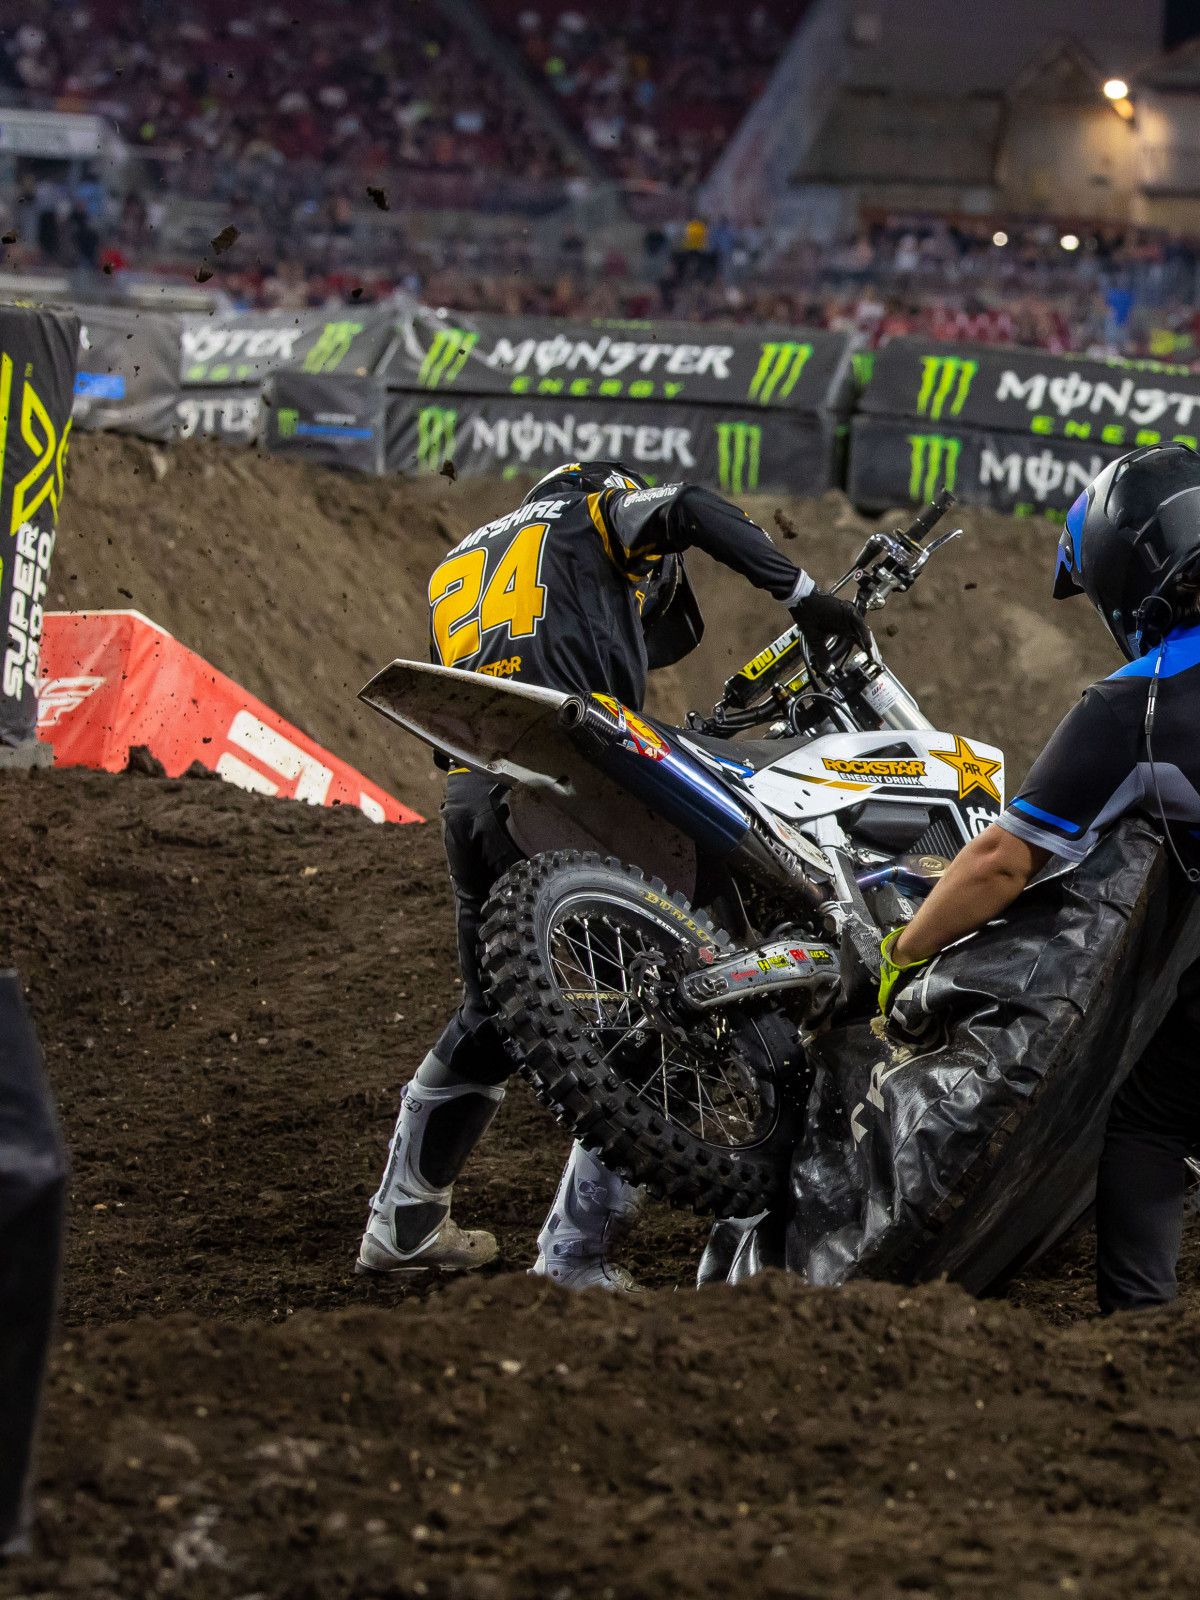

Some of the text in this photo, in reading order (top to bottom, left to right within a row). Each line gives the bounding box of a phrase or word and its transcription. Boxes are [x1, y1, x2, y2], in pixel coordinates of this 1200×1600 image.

[486, 334, 734, 379] MONSTER
[472, 412, 697, 468] MONSTER
[978, 448, 1104, 501] MON
[3, 521, 40, 701] SUPER
[25, 530, 52, 700] MOTO
[428, 523, 551, 667] 24
[823, 759, 926, 776] ROCKSTAR
[841, 772, 922, 785] ENERGY DRINK
